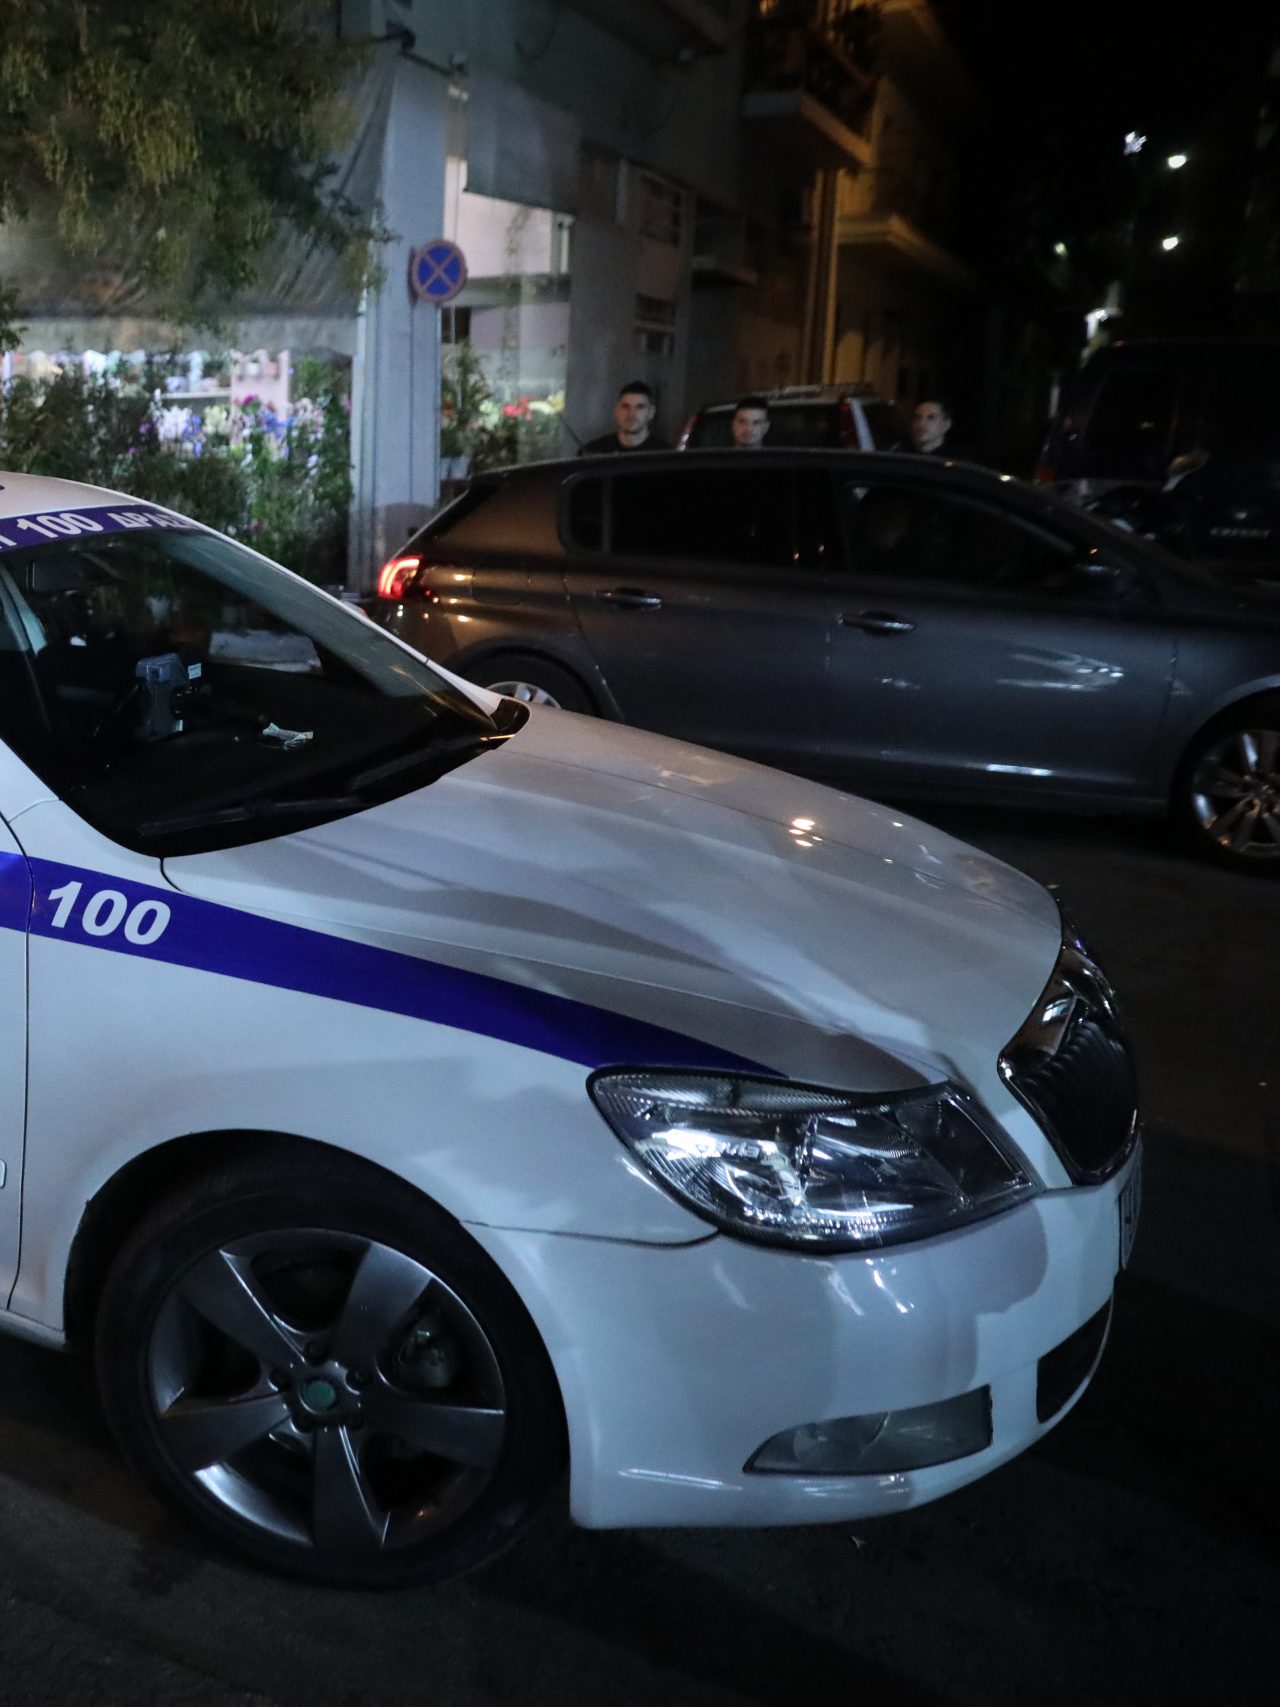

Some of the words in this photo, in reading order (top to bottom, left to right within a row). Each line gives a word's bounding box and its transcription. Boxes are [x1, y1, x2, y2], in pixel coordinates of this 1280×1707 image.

[16, 512, 104, 539] 100
[106, 512, 198, 530] ΔΡΑΣ
[47, 880, 171, 946] 100
